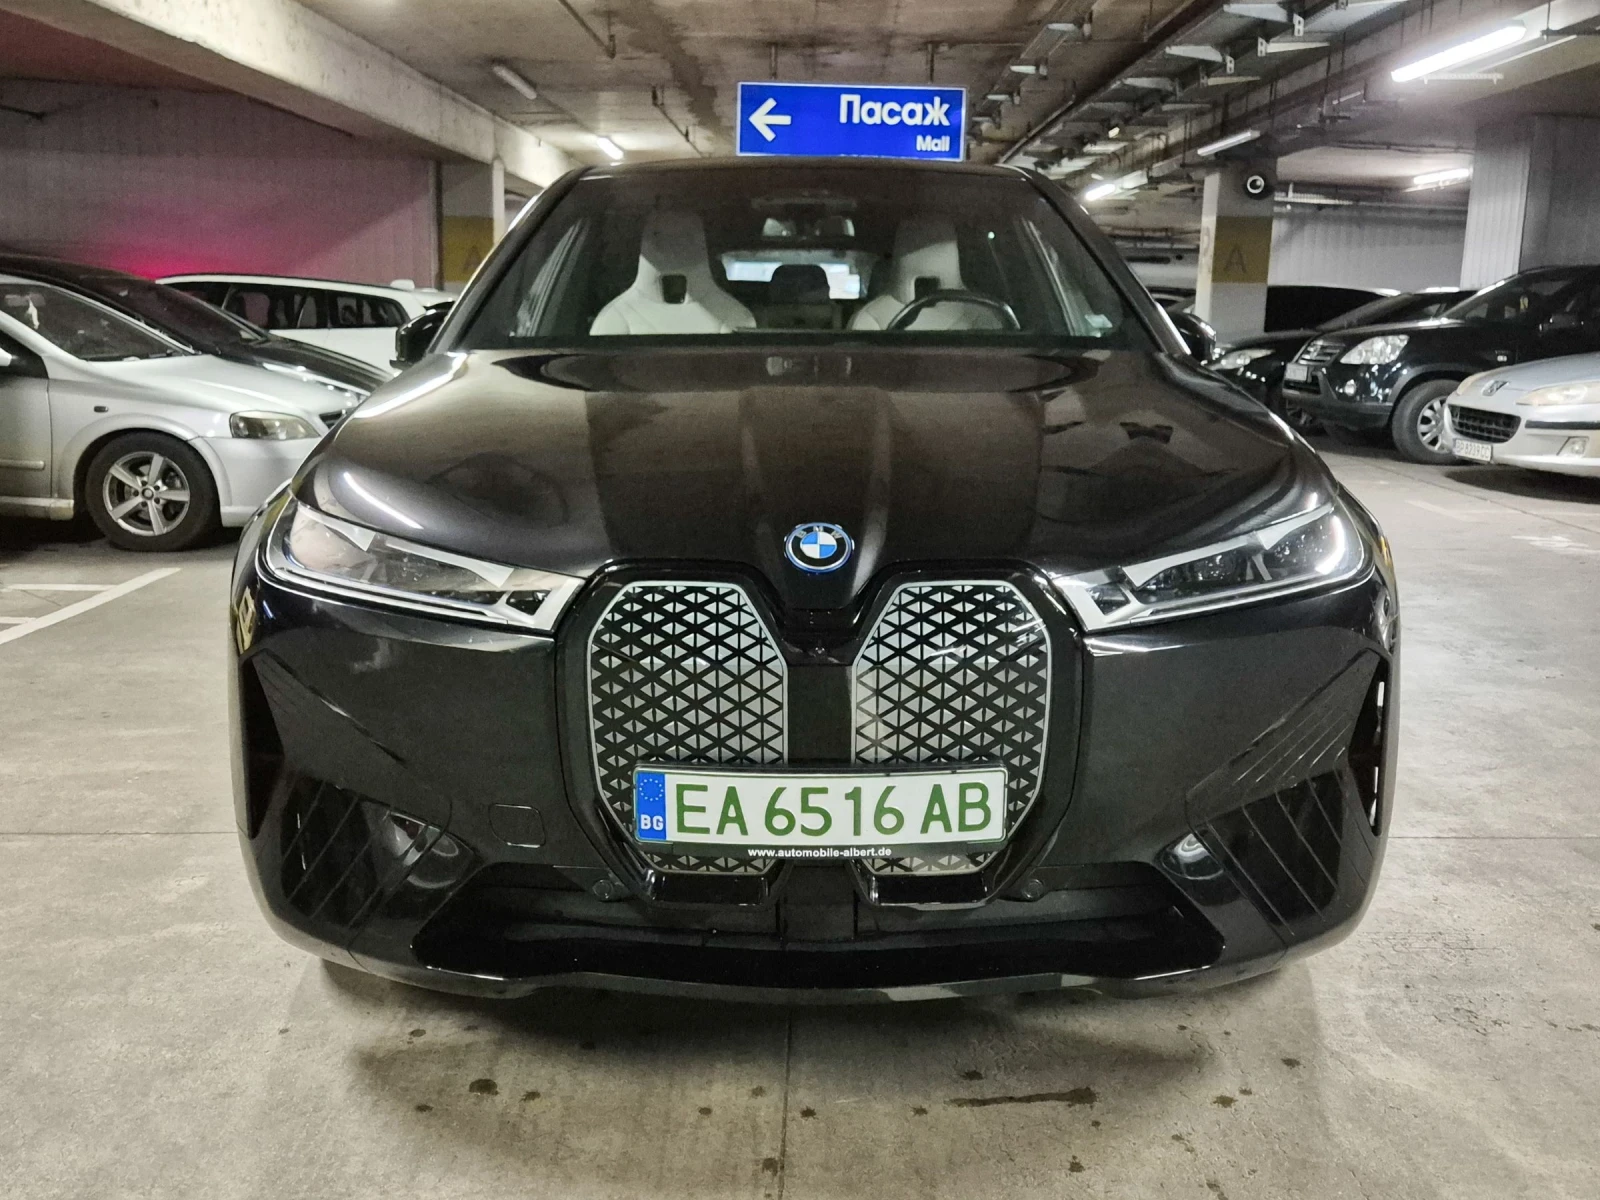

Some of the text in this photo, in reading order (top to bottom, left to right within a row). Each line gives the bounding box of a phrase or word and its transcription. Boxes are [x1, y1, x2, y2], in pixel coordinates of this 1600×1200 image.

[839, 93, 951, 127] Пасаж
[916, 134, 951, 152] Mall
[675, 781, 992, 837] EA 6516 AB
[640, 814, 664, 831] BG
[747, 846, 892, 858] www.automobile-albert.de
